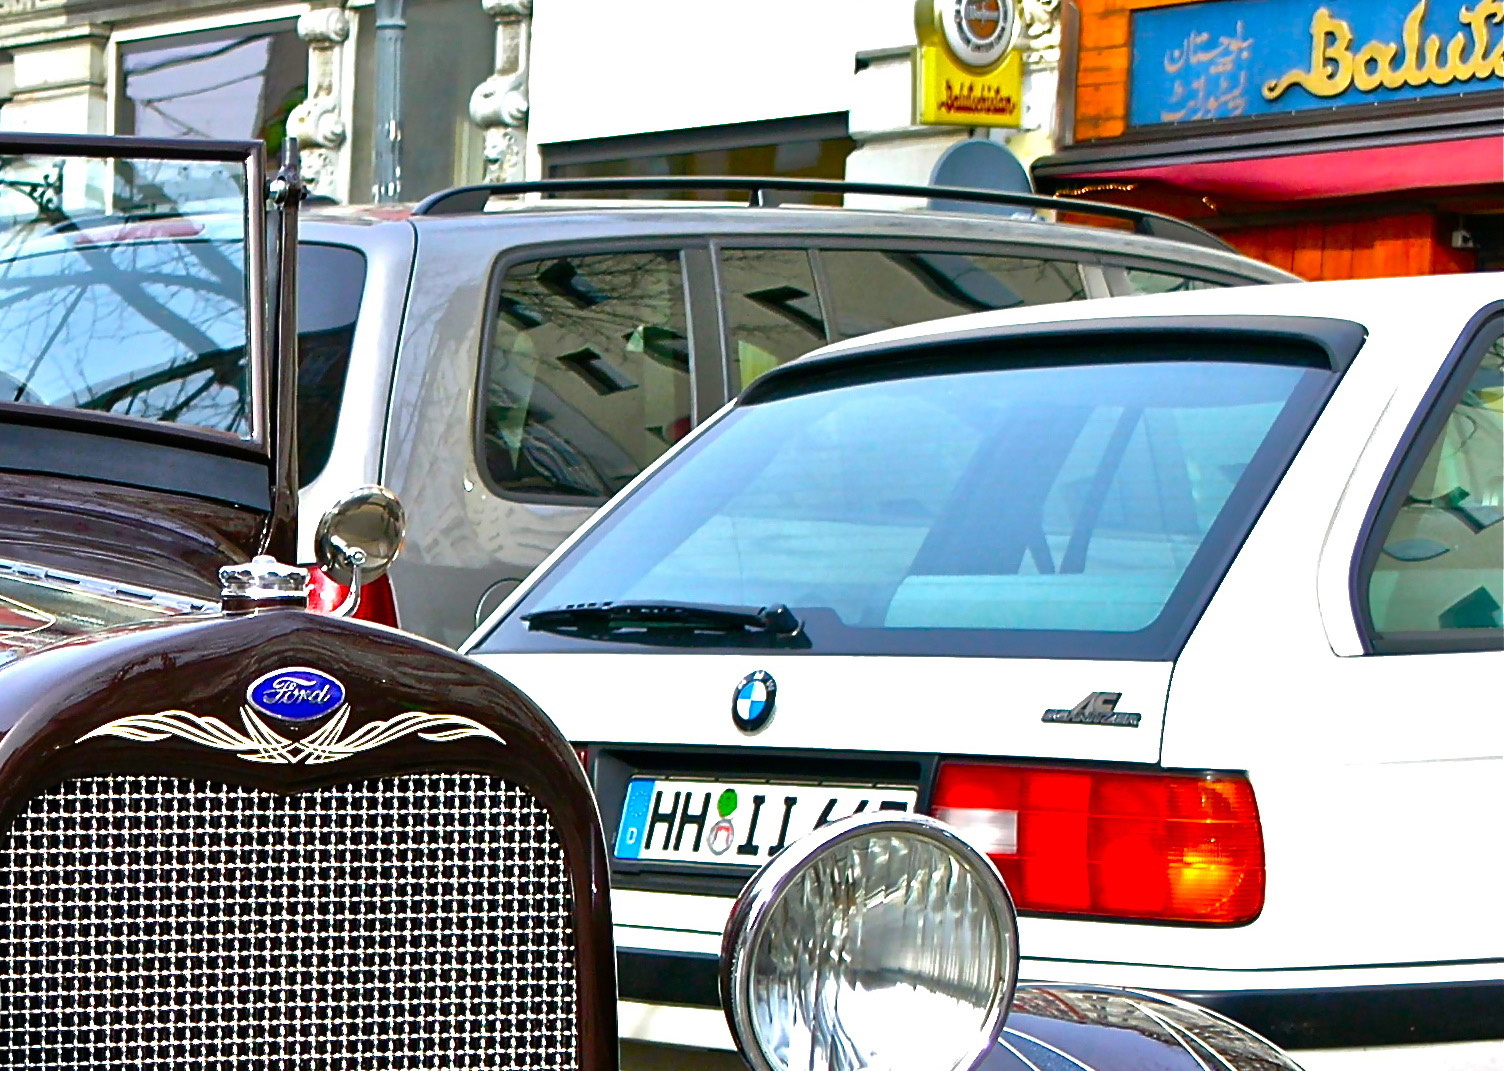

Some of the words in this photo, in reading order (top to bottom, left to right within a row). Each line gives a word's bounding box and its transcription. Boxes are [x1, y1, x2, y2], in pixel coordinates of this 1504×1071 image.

[262, 676, 331, 704] Ford
[644, 790, 712, 852] HH
[625, 827, 638, 845] D
